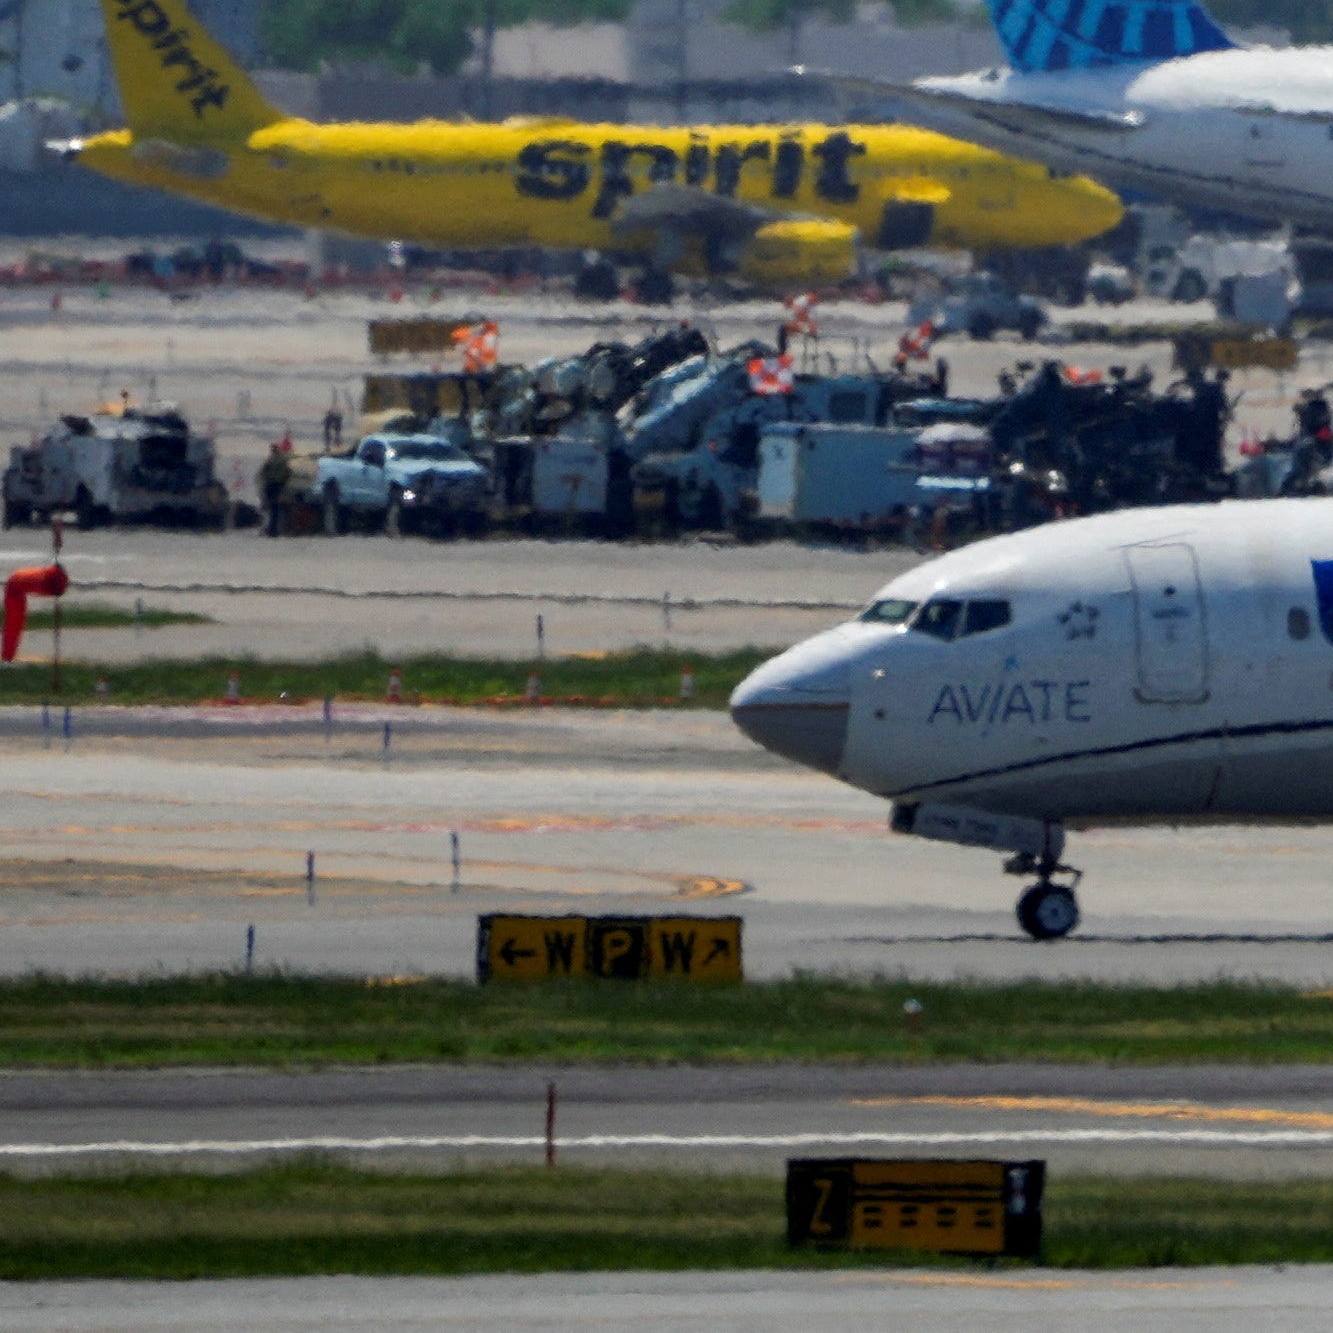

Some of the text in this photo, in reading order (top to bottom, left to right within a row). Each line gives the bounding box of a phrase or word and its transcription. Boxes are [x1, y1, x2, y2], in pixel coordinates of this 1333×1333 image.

[926, 679, 1091, 726] AVIATE
[546, 931, 694, 974] W P W
[810, 1178, 833, 1234] Z
